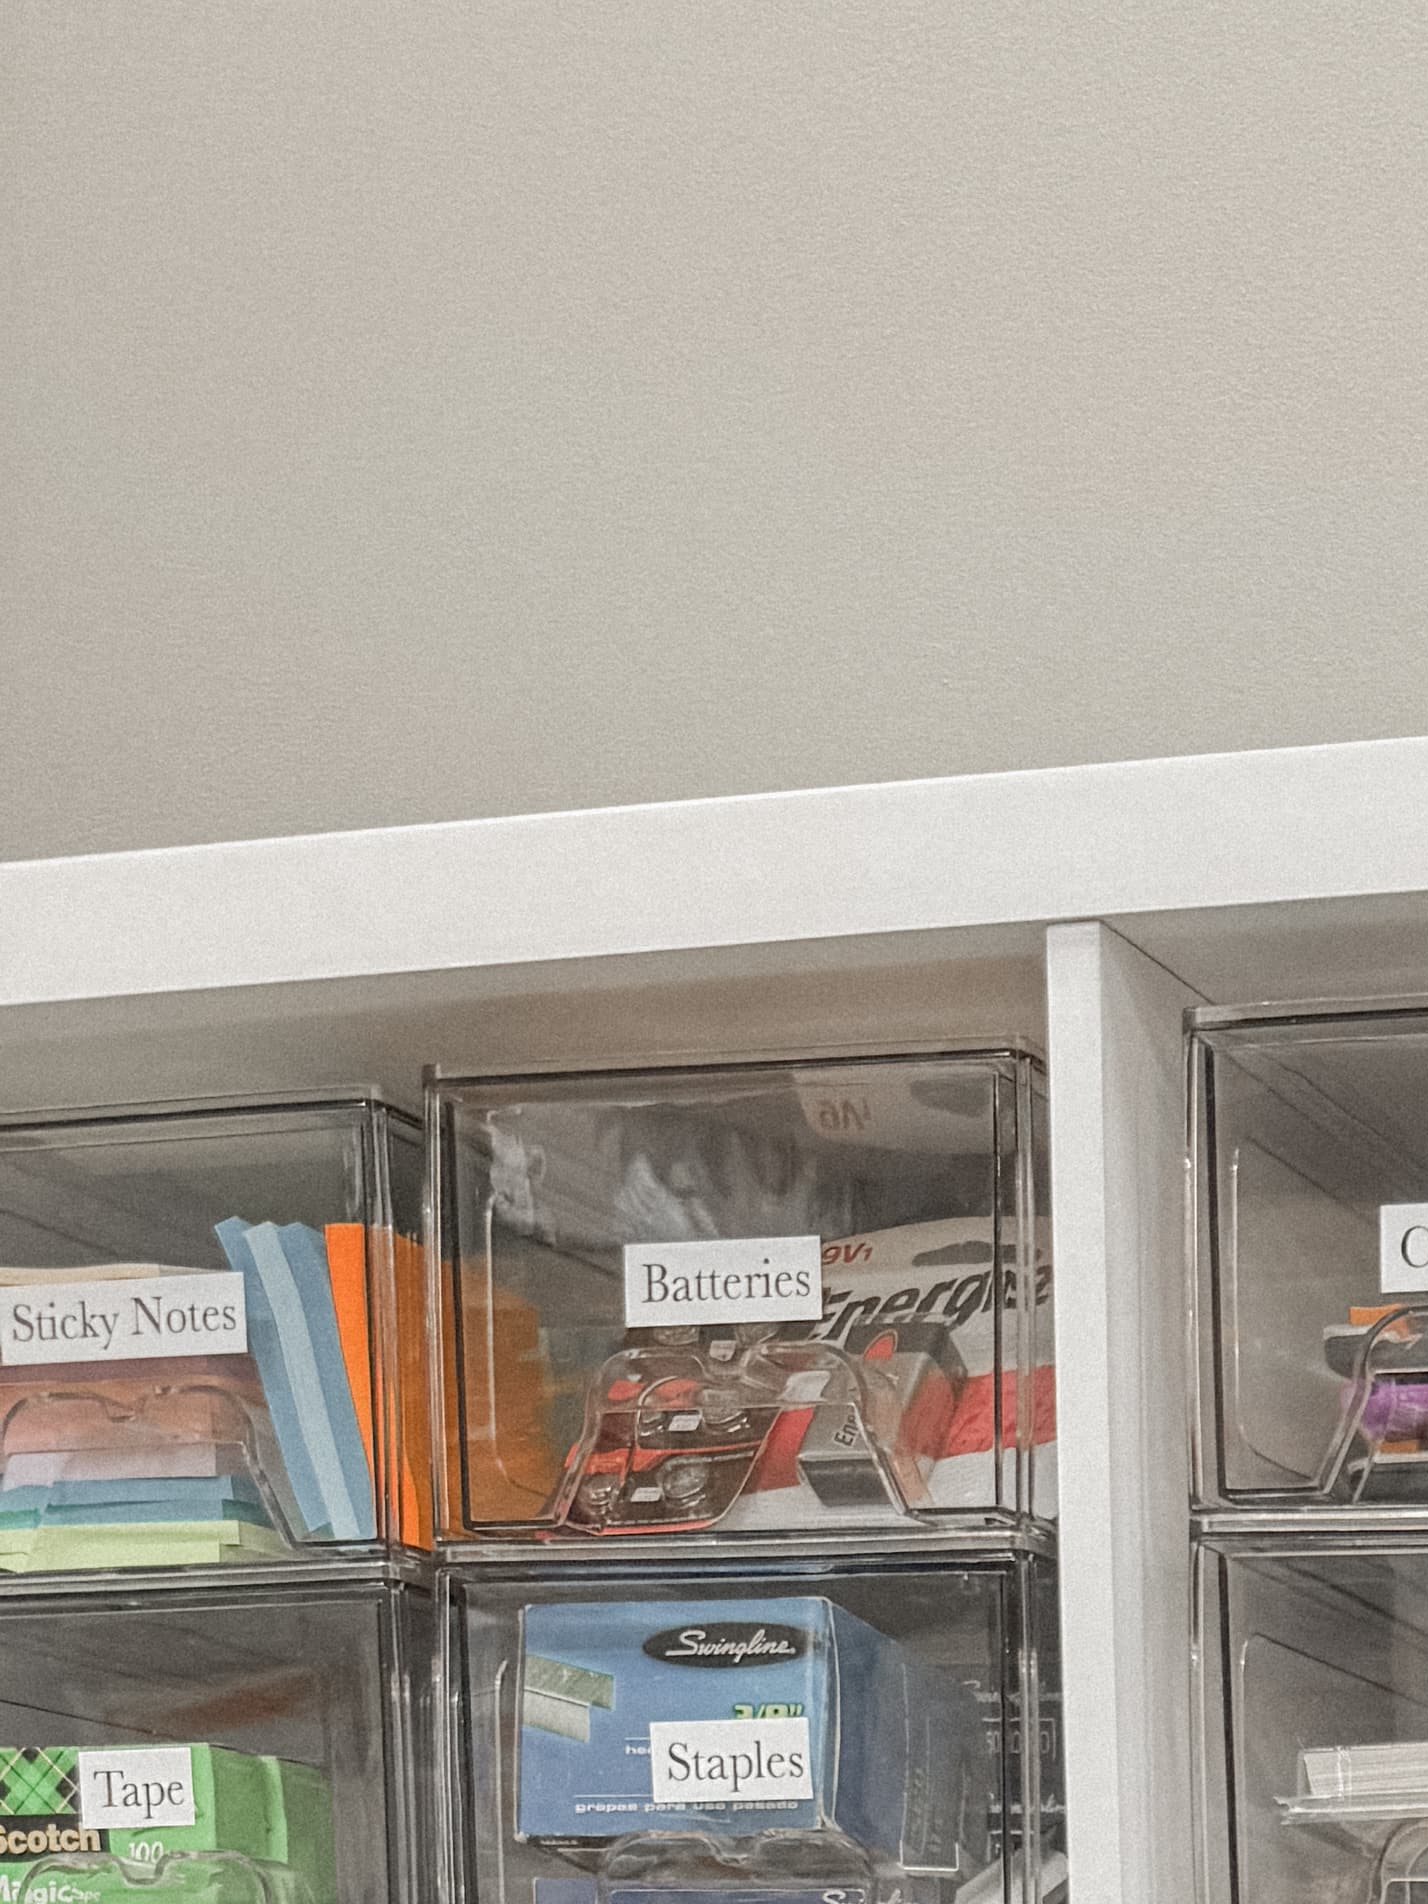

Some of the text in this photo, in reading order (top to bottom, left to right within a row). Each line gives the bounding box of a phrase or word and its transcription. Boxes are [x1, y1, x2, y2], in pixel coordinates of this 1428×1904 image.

[641, 1257, 811, 1304] Batteries
[12, 1296, 237, 1351] Sticky Notes
[665, 1629, 795, 1662] Swingline
[667, 1740, 805, 1793] Staples
[92, 1769, 185, 1820] Tape
